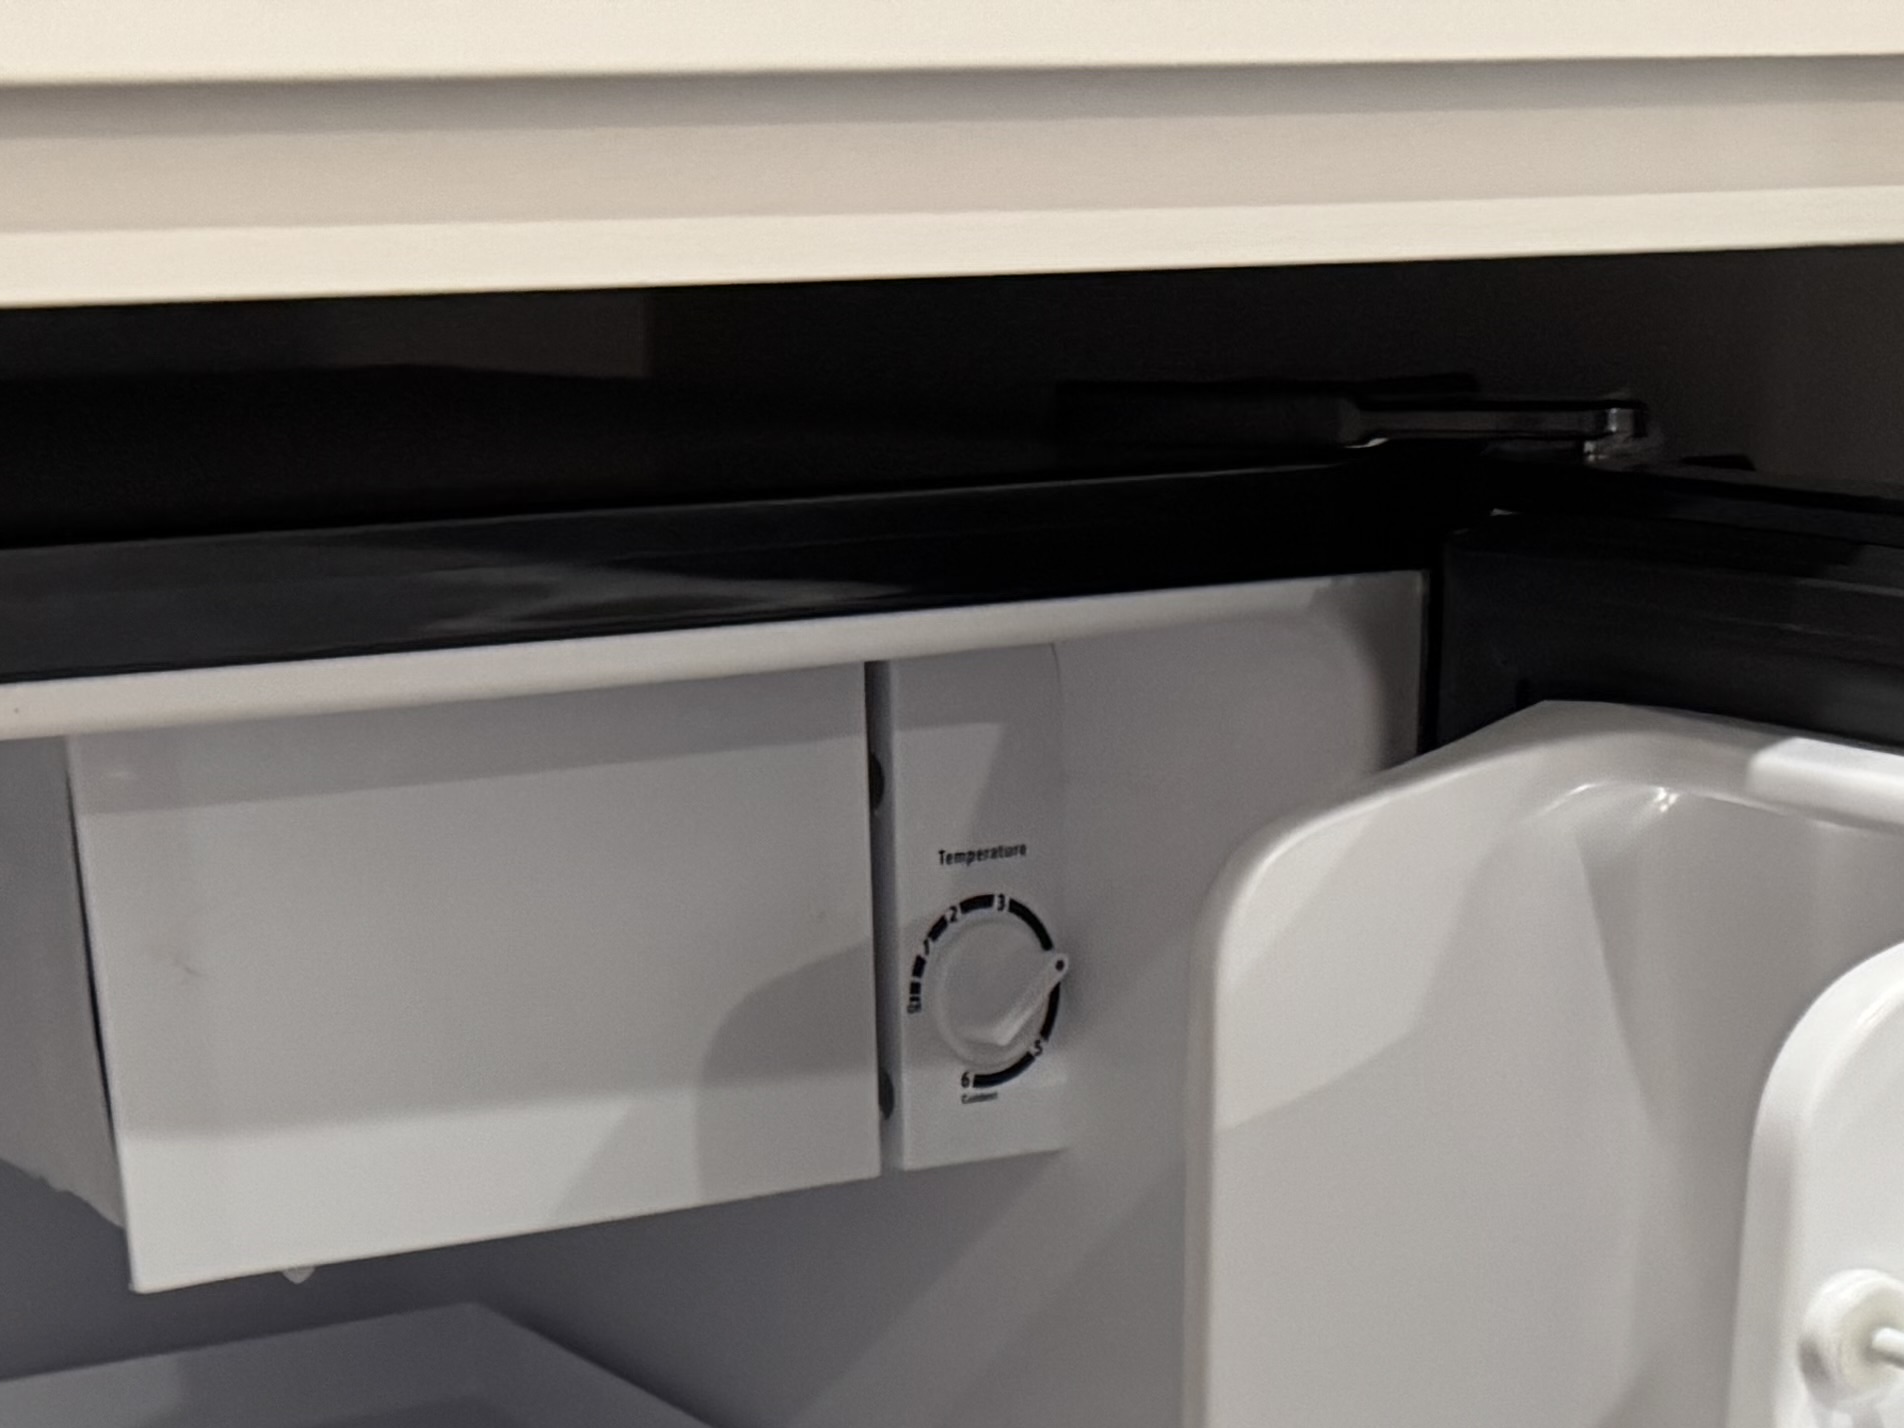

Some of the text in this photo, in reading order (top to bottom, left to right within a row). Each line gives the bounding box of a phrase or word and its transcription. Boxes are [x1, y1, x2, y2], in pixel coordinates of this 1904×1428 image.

[938, 844, 1027, 867] Temperature
[996, 893, 1006, 912] 3
[948, 905, 959, 924] 2
[922, 938, 931, 957] 1
[1033, 1038, 1044, 1058] 5
[960, 1070, 971, 1089] 6
